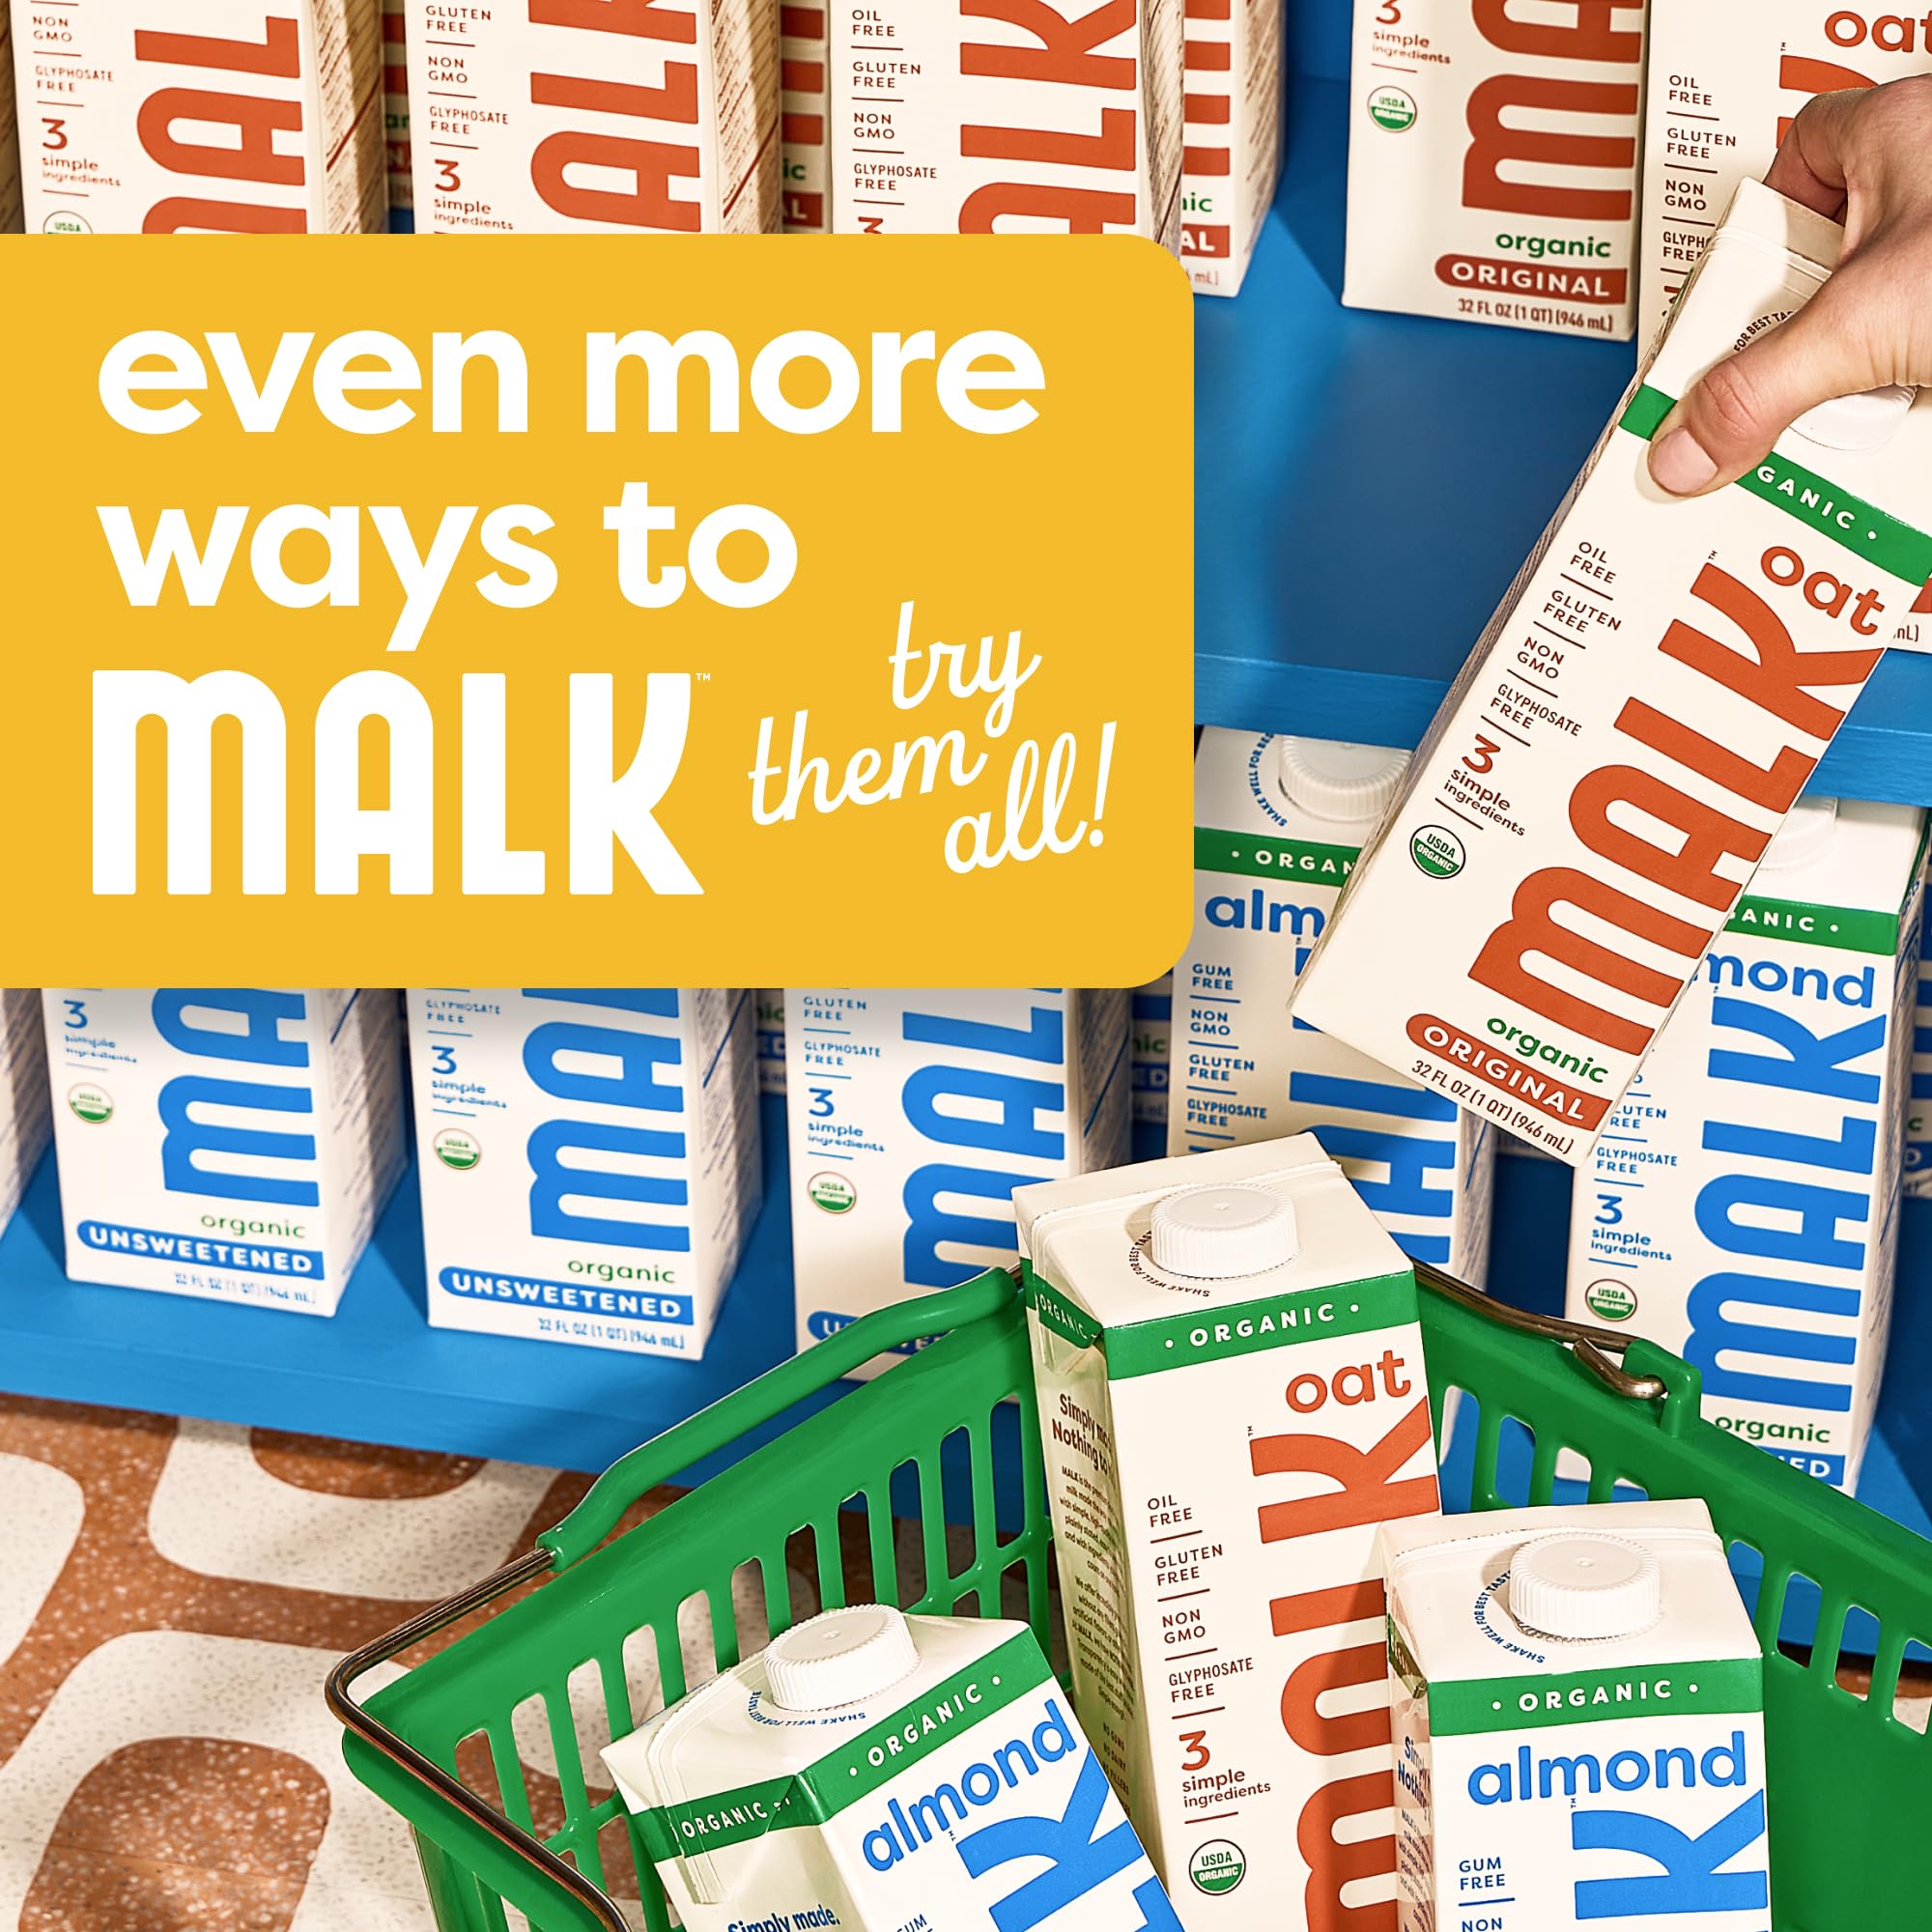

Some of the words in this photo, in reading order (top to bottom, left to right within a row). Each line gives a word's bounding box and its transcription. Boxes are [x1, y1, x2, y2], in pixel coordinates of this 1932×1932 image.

[33, 15, 69, 27] NON
[425, 5, 492, 20] GLUTEN
[852, 10, 881, 21] OIL
[426, 19, 468, 33] FREE
[852, 24, 895, 38] FREE
[33, 29, 72, 43] GMO
[1373, 30, 1430, 49] simple
[428, 56, 465, 69] NON
[1372, 44, 1451, 65] ingredients
[36, 65, 114, 82] GLYPHOSATE
[428, 70, 469, 84] GMO
[853, 62, 922, 75] GLUTEN
[37, 80, 76, 93] FREE
[853, 76, 896, 89] FREE
[1669, 74, 1699, 89] OIL
[1668, 90, 1713, 107] FREE
[430, 106, 509, 125] GLYPHOSATE
[854, 113, 892, 125] NON
[42, 117, 68, 150] 3
[431, 121, 470, 134] FREE
[854, 127, 895, 140] GMO
[1667, 128, 1737, 147] GLUTEN
[1666, 143, 1710, 159] FREE
[43, 156, 99, 171] simple
[854, 163, 937, 179] GLYPHOSATE
[43, 170, 121, 186] ingredients
[434, 158, 461, 192] 3
[854, 178, 896, 191] FREE
[1665, 179, 1704, 196] NON
[434, 196, 492, 214] simple
[1664, 195, 1707, 212] GMO
[435, 213, 513, 230] ingredients
[1495, 232, 1611, 259] organic
[1451, 261, 1610, 298] ORIGINAL
[1458, 298, 1474, 314] 32
[1477, 300, 1492, 317] FL
[1495, 302, 1513, 319] OZ
[1734, 333, 1750, 352] FOR
[1747, 316, 1771, 335] BEST
[1757, 465, 1856, 530] GANIC
[1578, 541, 1607, 564] OIL
[1570, 555, 1616, 584] FREE
[1760, 546, 1885, 636] oat
[1543, 603, 1589, 633] FREE
[1551, 589, 1622, 631] GLUTEN
[1524, 637, 1565, 666] NON
[1517, 651, 1559, 679] GMO
[1490, 697, 1535, 730] FREE
[1497, 683, 1582, 737] GLYPHOSATE
[1462, 734, 1501, 774] 3
[1450, 768, 1512, 812] simple
[1443, 780, 1525, 838] ingredients
[1468, 562, 1887, 1056] MALK
[1426, 834, 1456, 859] USDA
[1255, 850, 1357, 875] ORGAN
[1416, 843, 1454, 872] ORGANIC
[1205, 889, 1326, 937] alm
[1192, 963, 1232, 978] GUM
[1192, 977, 1234, 991] FREE
[1692, 952, 1875, 1009] mond
[804, 996, 867, 1010] GLUTEN
[63, 999, 89, 1029] 3
[804, 1009, 843, 1021] FREE
[1191, 1009, 1228, 1022] NON
[1190, 1022, 1231, 1037] GMO
[805, 1040, 881, 1058] GLYPHOSATE
[1487, 1017, 1609, 1084] organic
[432, 1045, 457, 1075] 3
[805, 1054, 844, 1066] FREE
[1189, 1054, 1255, 1071] GLUTEN
[1189, 1067, 1230, 1082] FREE
[1423, 1026, 1584, 1121] ORIGINAL
[809, 1088, 836, 1117] 3
[1187, 1098, 1267, 1120] GLYPHOSATE
[1411, 1061, 1431, 1079] 32
[1431, 1068, 1449, 1089] FL
[1451, 1079, 1471, 1098] OZ
[1510, 1111, 1544, 1139] (946
[1546, 1133, 1575, 1154] mL)
[1187, 1112, 1228, 1126] FREE
[808, 1122, 864, 1138] simple
[1597, 1147, 1678, 1167] GLYPHOSATE
[1597, 1161, 1637, 1174] FREE
[1594, 1194, 1624, 1225] 3
[200, 1213, 306, 1239] organic
[1592, 1228, 1652, 1247] simple
[89, 1226, 314, 1273] UNSWEETENED
[1129, 1247, 1141, 1262] BEST
[1591, 1240, 1672, 1262] ingredients
[567, 1260, 676, 1284] organic
[451, 1272, 682, 1319] UNSWEETENED
[1168, 1286, 1210, 1296] SHAKE
[1598, 1289, 1627, 1301] USDA
[1040, 1295, 1087, 1340] ORGANIC
[1189, 1304, 1335, 1347] ORGANIC
[1286, 1350, 1410, 1413] oat
[1060, 1393, 1094, 1440] Simply
[1715, 1415, 1831, 1443] organic
[1052, 1418, 1098, 1471] Nothing
[1148, 1494, 1178, 1511] OIL
[1150, 1508, 1193, 1527] FREE
[1154, 1545, 1223, 1570] GLUTEN
[1156, 1567, 1201, 1586] FREE
[1474, 1592, 1491, 1608] BEST
[1162, 1609, 1201, 1627] NON
[1474, 1610, 1487, 1625] FOR
[1164, 1626, 1206, 1644] GMO
[1481, 1625, 1504, 1644] WELL
[1502, 1642, 1545, 1663] SHAKE
[1169, 1658, 1254, 1687] GLYPHOSATE
[1171, 1684, 1215, 1703] FREE
[1519, 1679, 1672, 1712] ORGANIC
[820, 1712, 867, 1724] SHAKE
[867, 1683, 983, 1768] ORGANIC
[1179, 1730, 1210, 1771] 3
[1467, 1731, 1747, 1805] almond
[862, 1698, 1078, 1872] almond
[1181, 1769, 1246, 1794] simple
[1183, 1781, 1271, 1809] ingredients
[681, 1802, 768, 1838] ORGANIC
[1201, 1852, 1233, 1867] USDA
[1459, 1857, 1501, 1873] GUM
[1199, 1865, 1239, 1882] ORGANIC
[1460, 1874, 1505, 1890] FREE
[1462, 1918, 1503, 1932] NON
